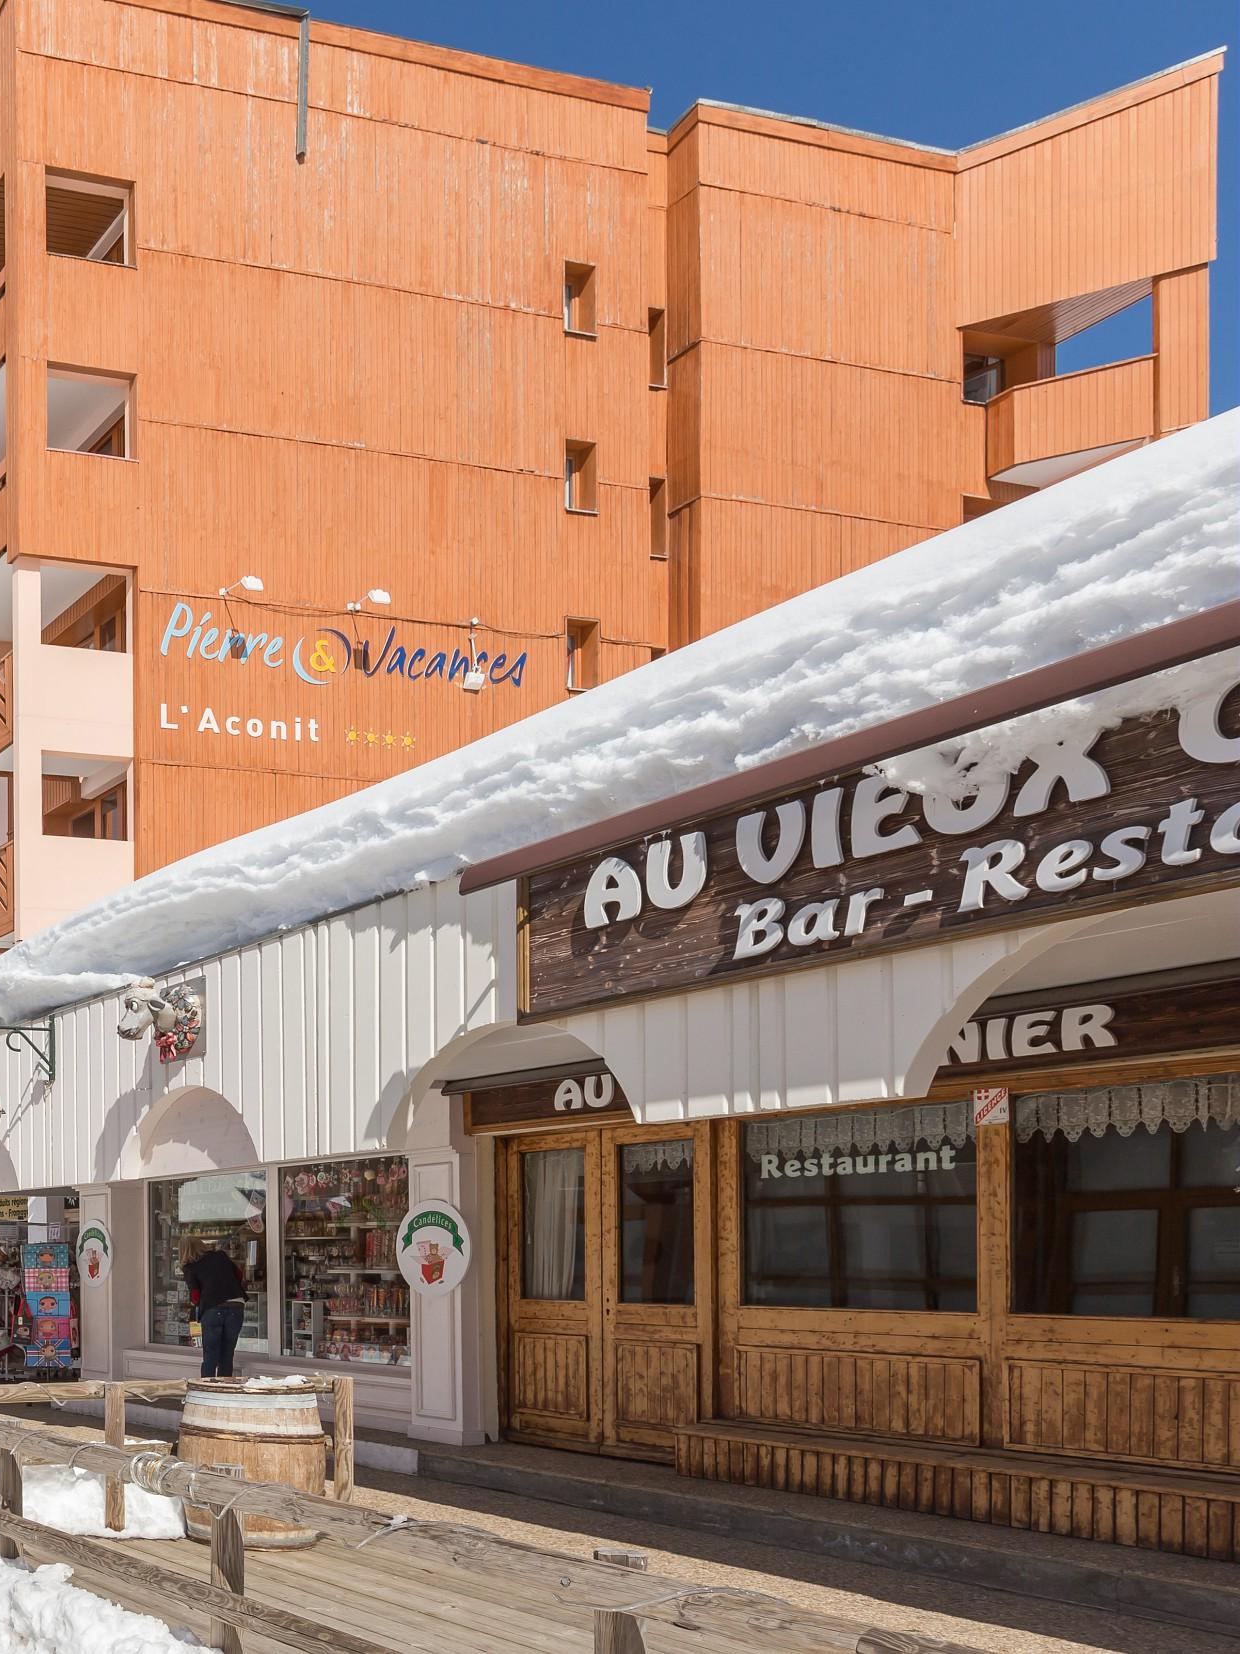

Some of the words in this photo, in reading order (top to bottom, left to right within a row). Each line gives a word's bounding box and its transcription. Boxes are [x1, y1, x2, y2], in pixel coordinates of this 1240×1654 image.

[160, 602, 284, 668] Pierre
[309, 640, 337, 674] &
[362, 626, 528, 687] Vacances
[160, 703, 320, 742] L'Aconit
[583, 830, 708, 929] AU
[733, 888, 885, 960] Bar
[554, 1073, 615, 1111] AU
[976, 1089, 1007, 1122] LICENCE
[760, 1145, 956, 1179] Restaurant
[413, 1214, 452, 1229] Candélices
